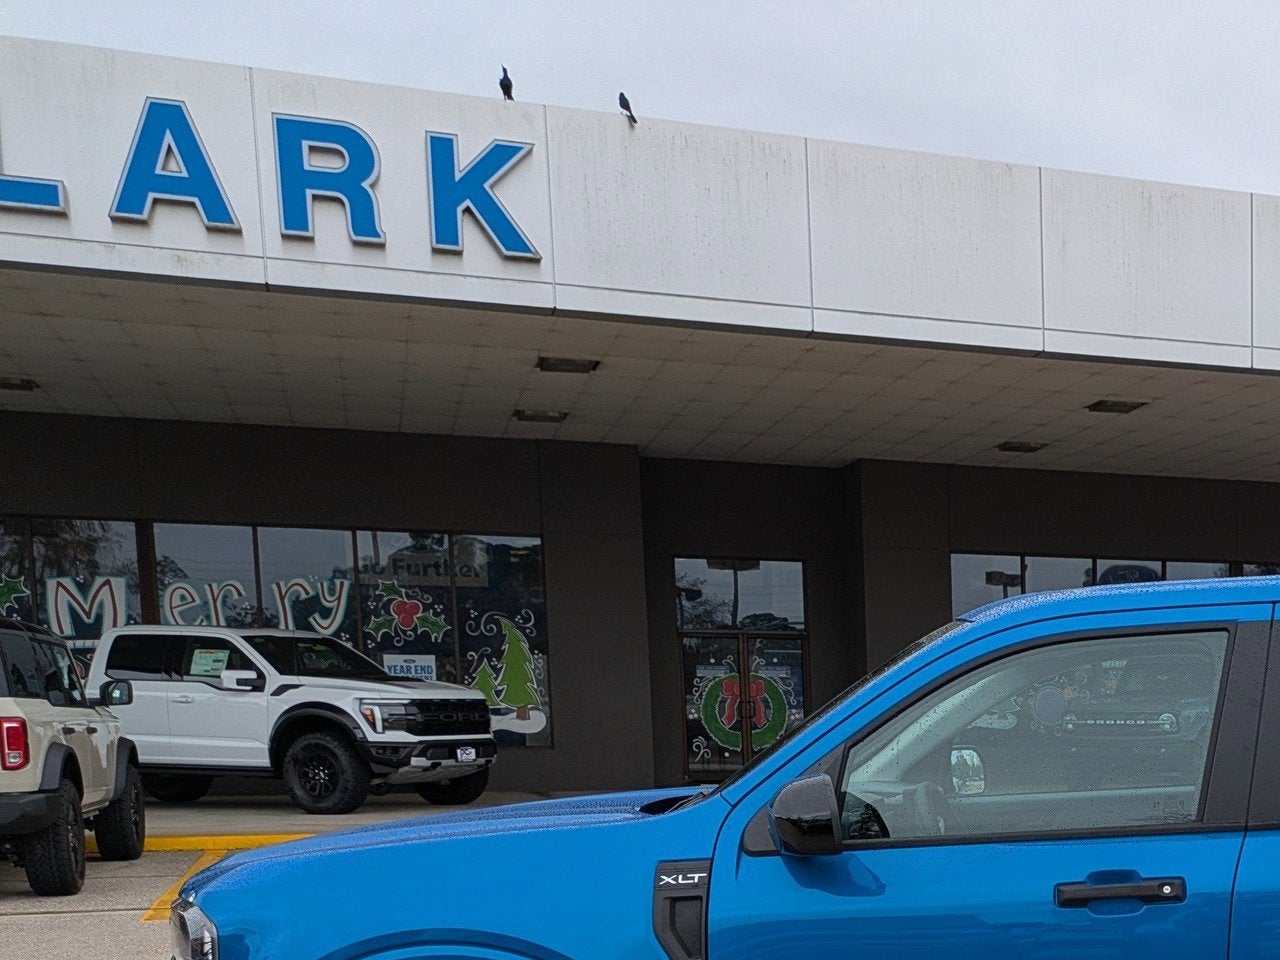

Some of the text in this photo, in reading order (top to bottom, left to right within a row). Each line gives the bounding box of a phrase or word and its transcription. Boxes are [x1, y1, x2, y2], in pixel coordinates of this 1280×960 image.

[46, 575, 348, 637] Merry
[386, 664, 433, 675] YEAR END
[420, 712, 487, 722] FORD
[659, 873, 707, 884] XLT
